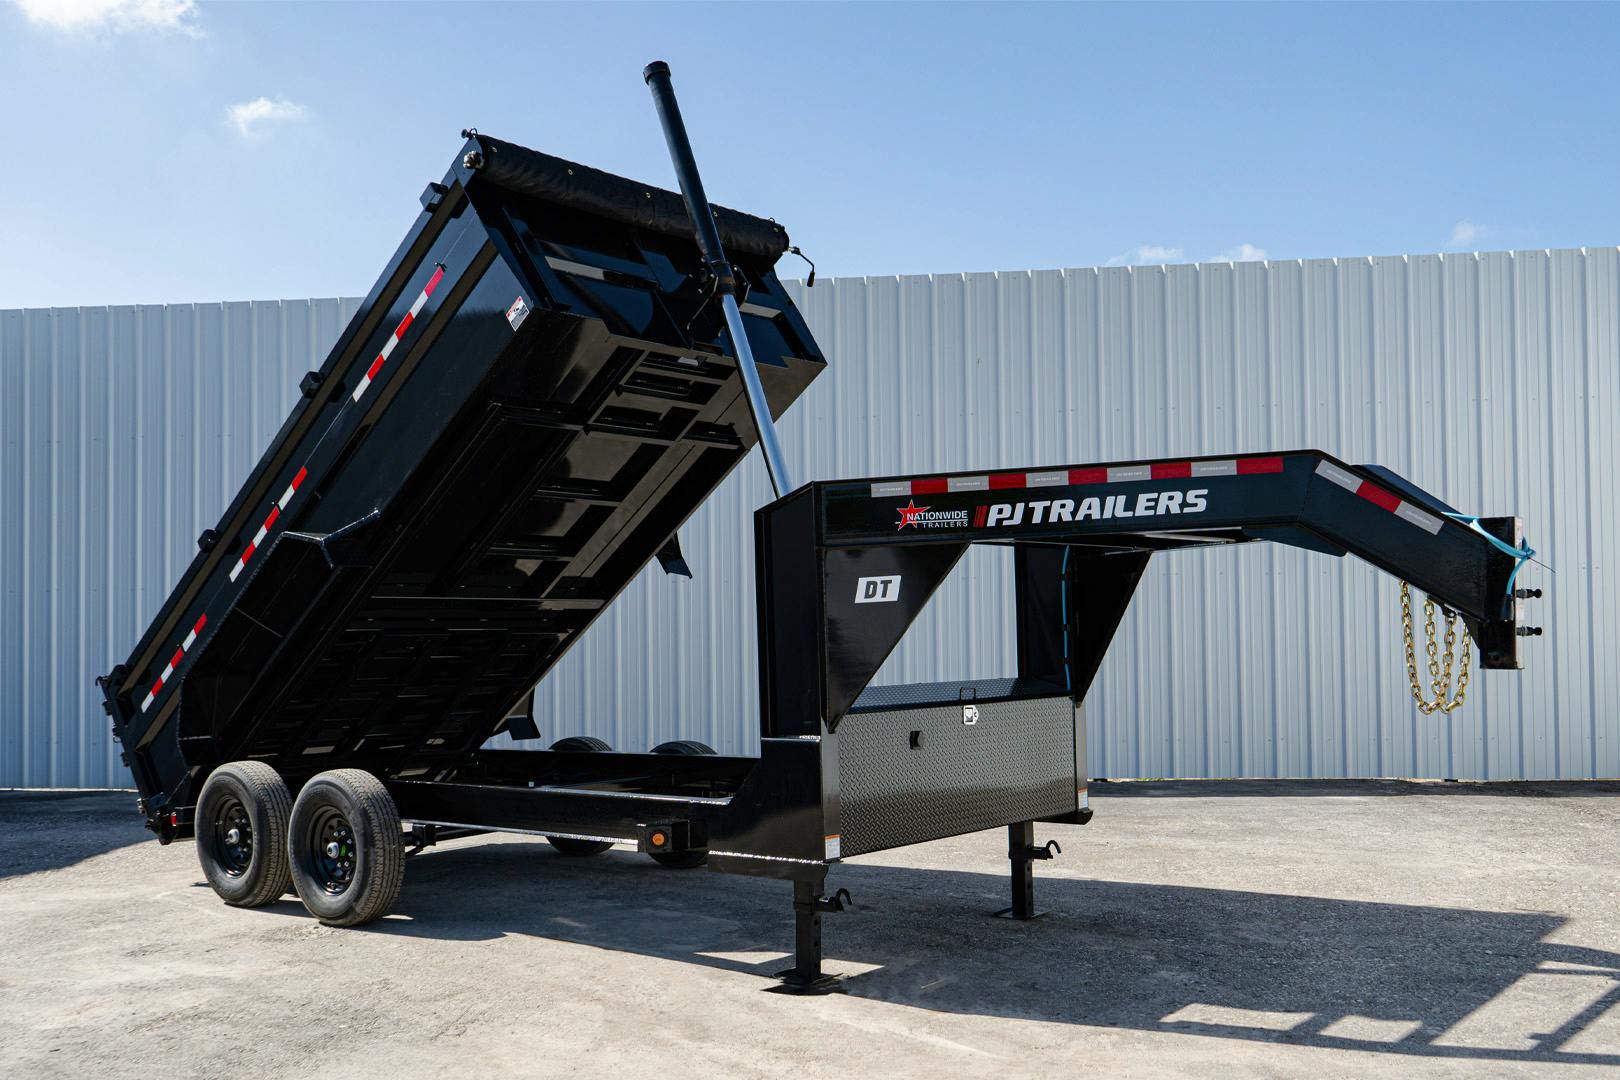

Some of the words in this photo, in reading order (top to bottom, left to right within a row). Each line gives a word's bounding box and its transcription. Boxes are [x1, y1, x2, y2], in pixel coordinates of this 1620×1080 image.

[906, 510, 968, 521] NATIONWIDE
[987, 502, 1025, 528] PJ
[1028, 488, 1209, 524] TRAILERS
[922, 520, 968, 529] TRAILERS
[863, 579, 893, 600] DT
